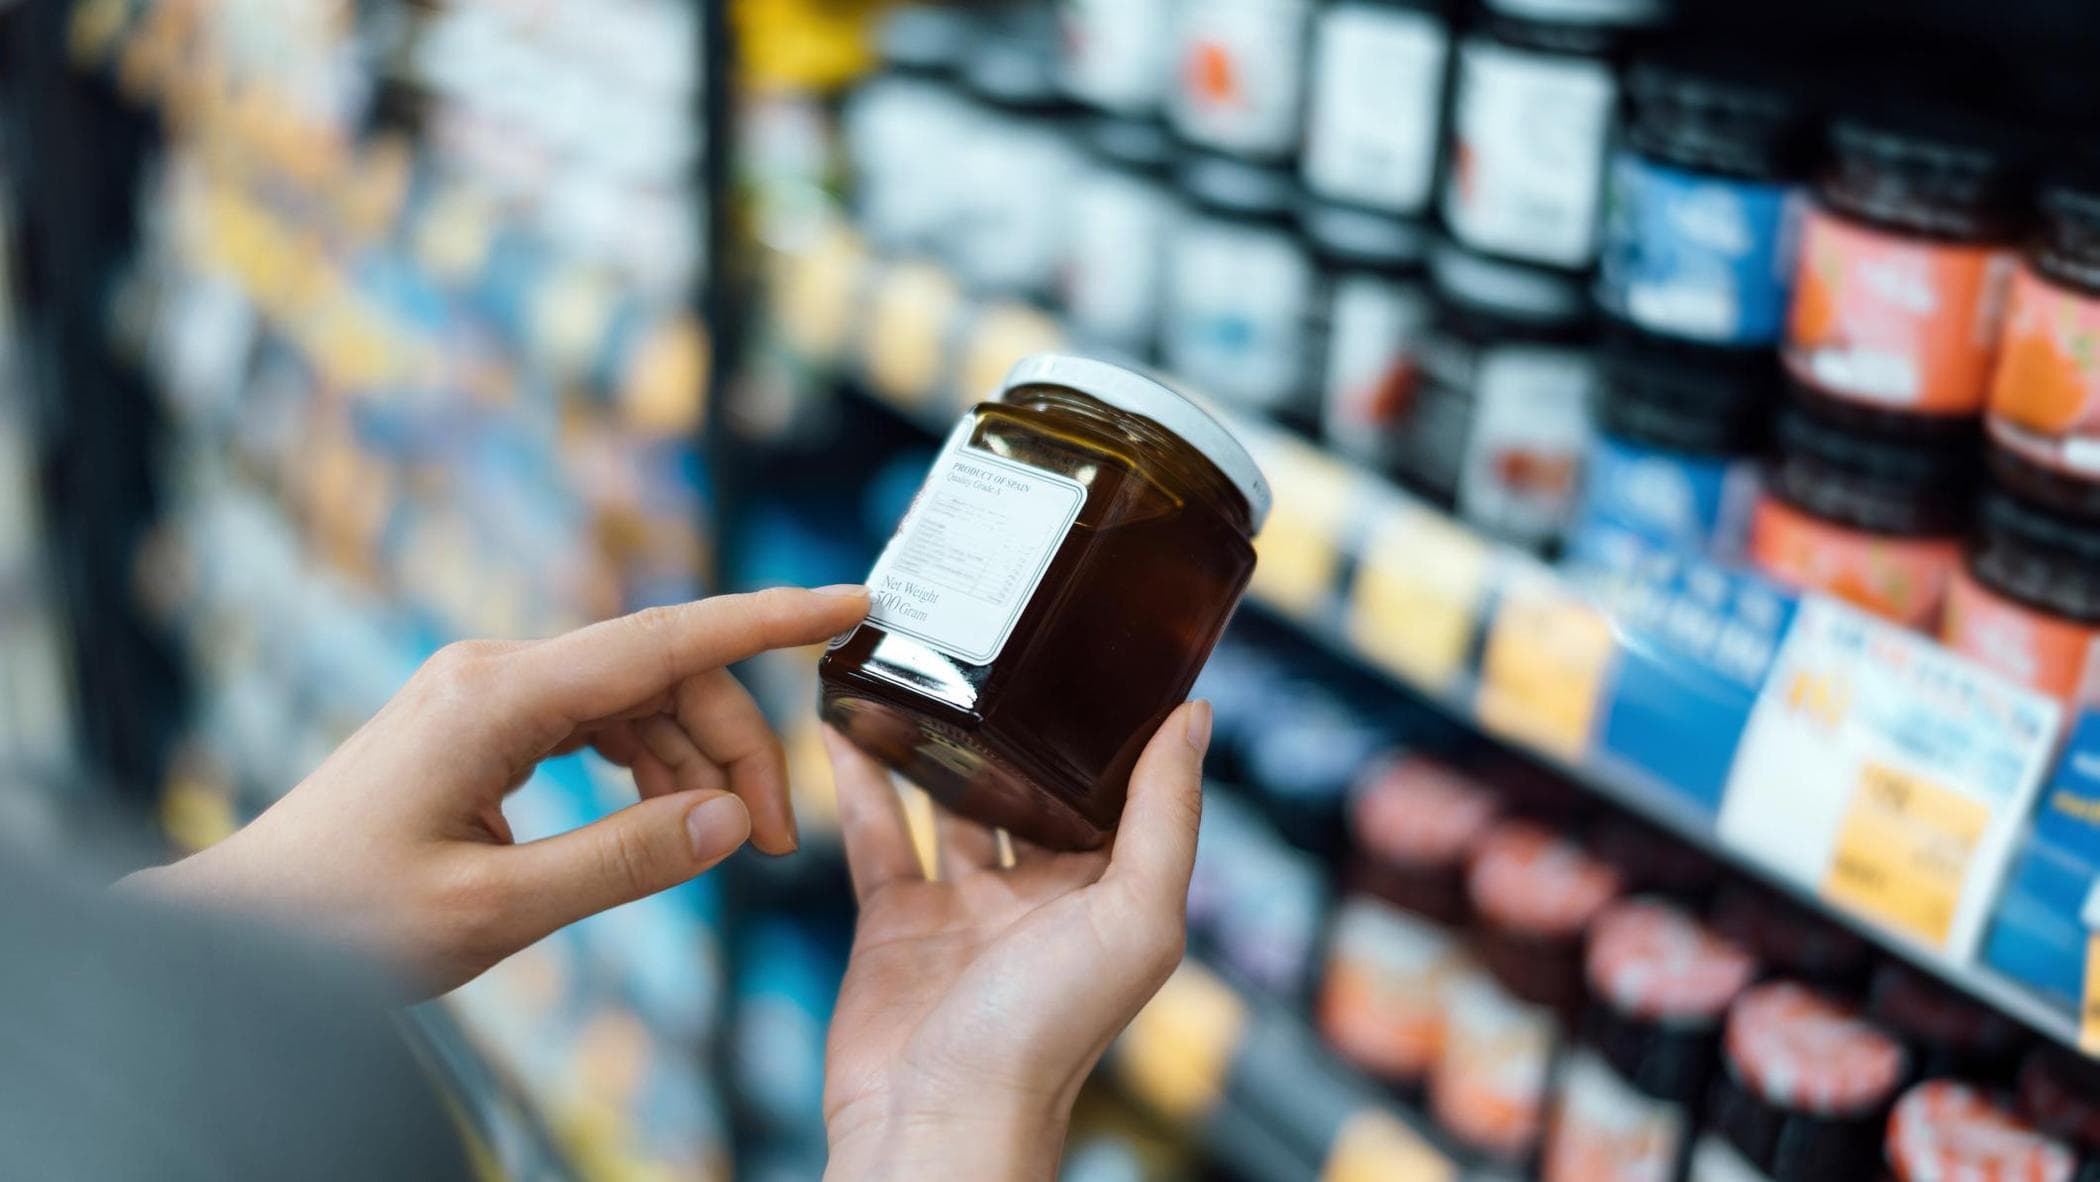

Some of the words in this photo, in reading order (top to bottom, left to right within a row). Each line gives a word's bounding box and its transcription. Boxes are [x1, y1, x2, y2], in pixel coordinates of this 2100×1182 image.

[946, 471, 972, 488] Quality
[972, 479, 995, 493] Grade
[952, 462, 993, 481] PRODUCT
[994, 474, 1007, 485] OF
[1007, 479, 1031, 492] SPAIN
[881, 575, 902, 591] Net
[905, 582, 939, 604] Weight
[899, 602, 928, 622] Gram
